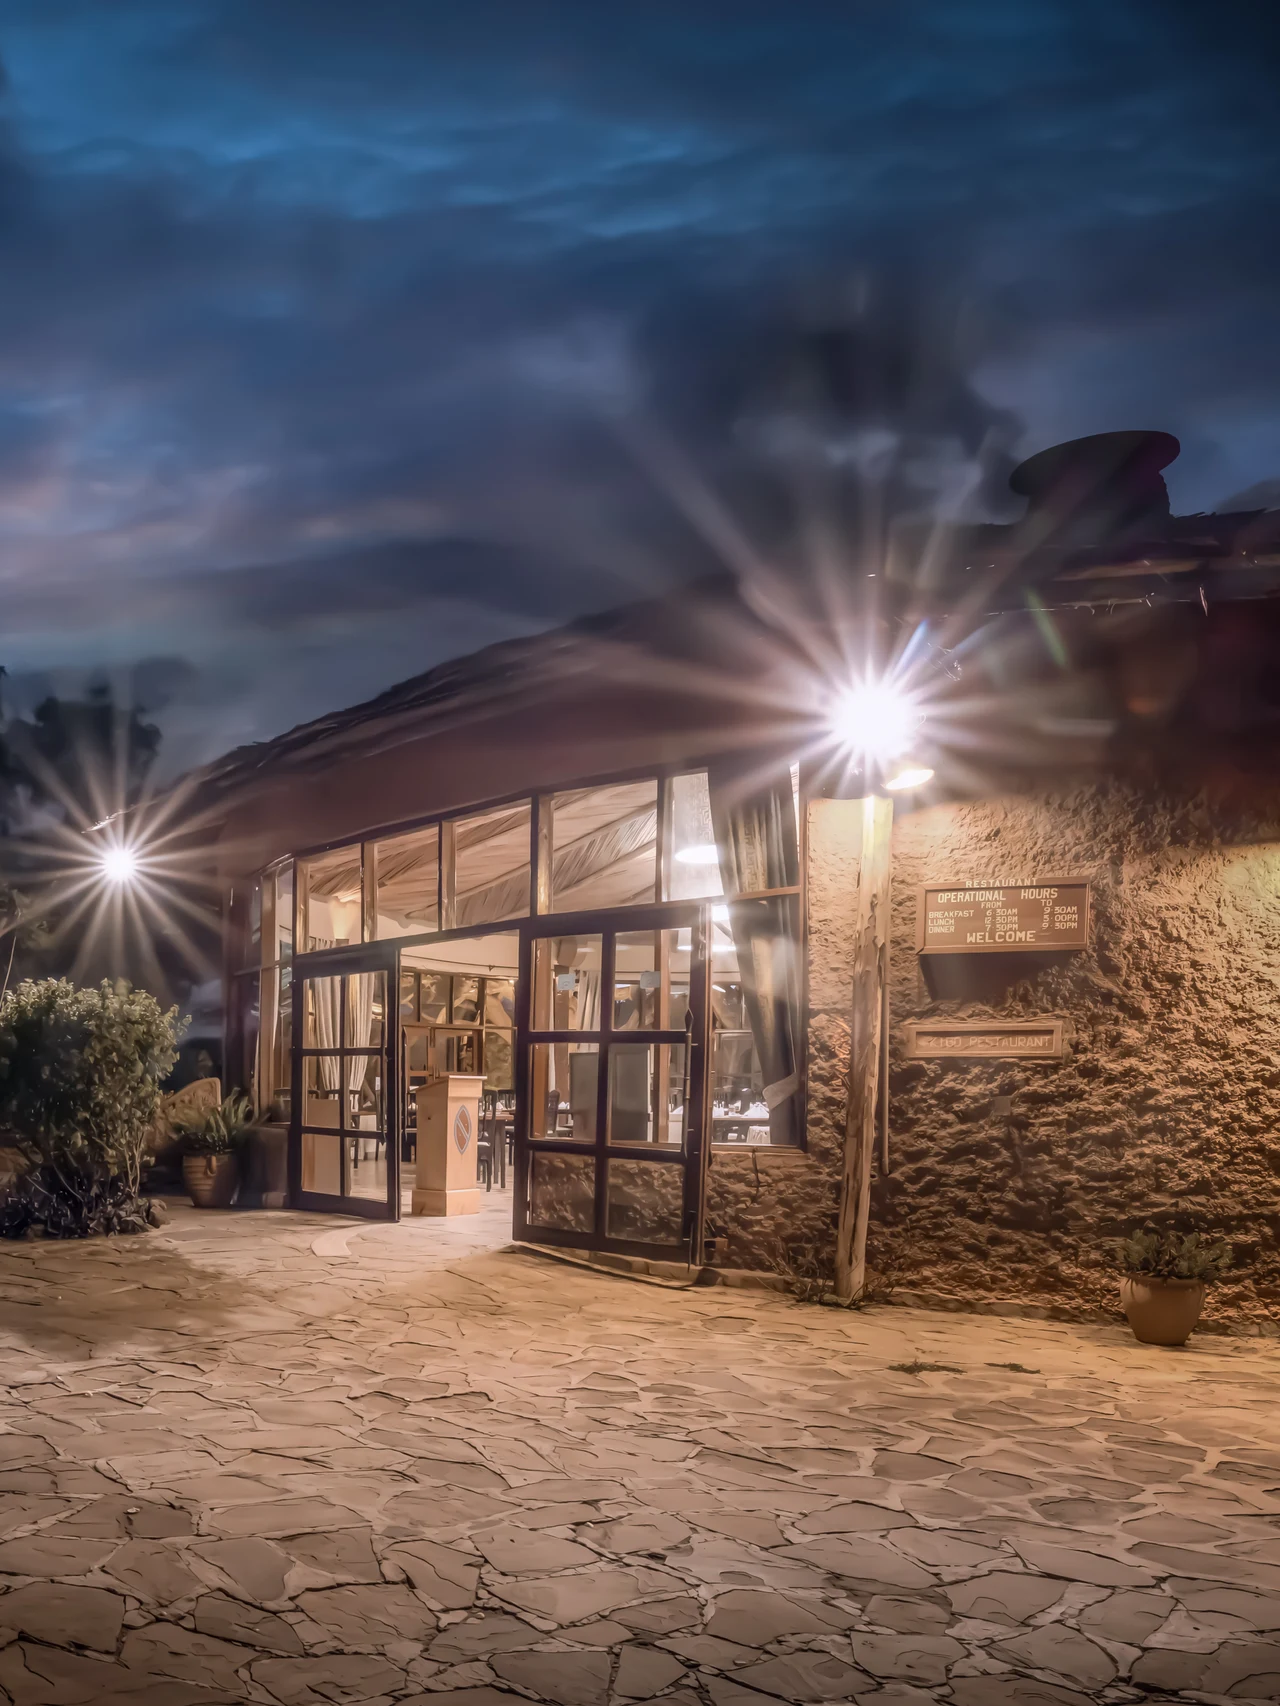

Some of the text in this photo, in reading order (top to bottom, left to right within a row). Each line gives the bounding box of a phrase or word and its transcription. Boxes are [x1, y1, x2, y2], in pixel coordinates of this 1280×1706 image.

[966, 878, 1037, 888] RESTAURANT
[937, 888, 1058, 903] OPERATIONAL HOURS
[981, 899, 1053, 909] FROM TO
[928, 910, 974, 918] BREAKFAST
[928, 918, 955, 926] LUNCH
[928, 926, 955, 934] DINNER
[966, 931, 1036, 943] WELCOME
